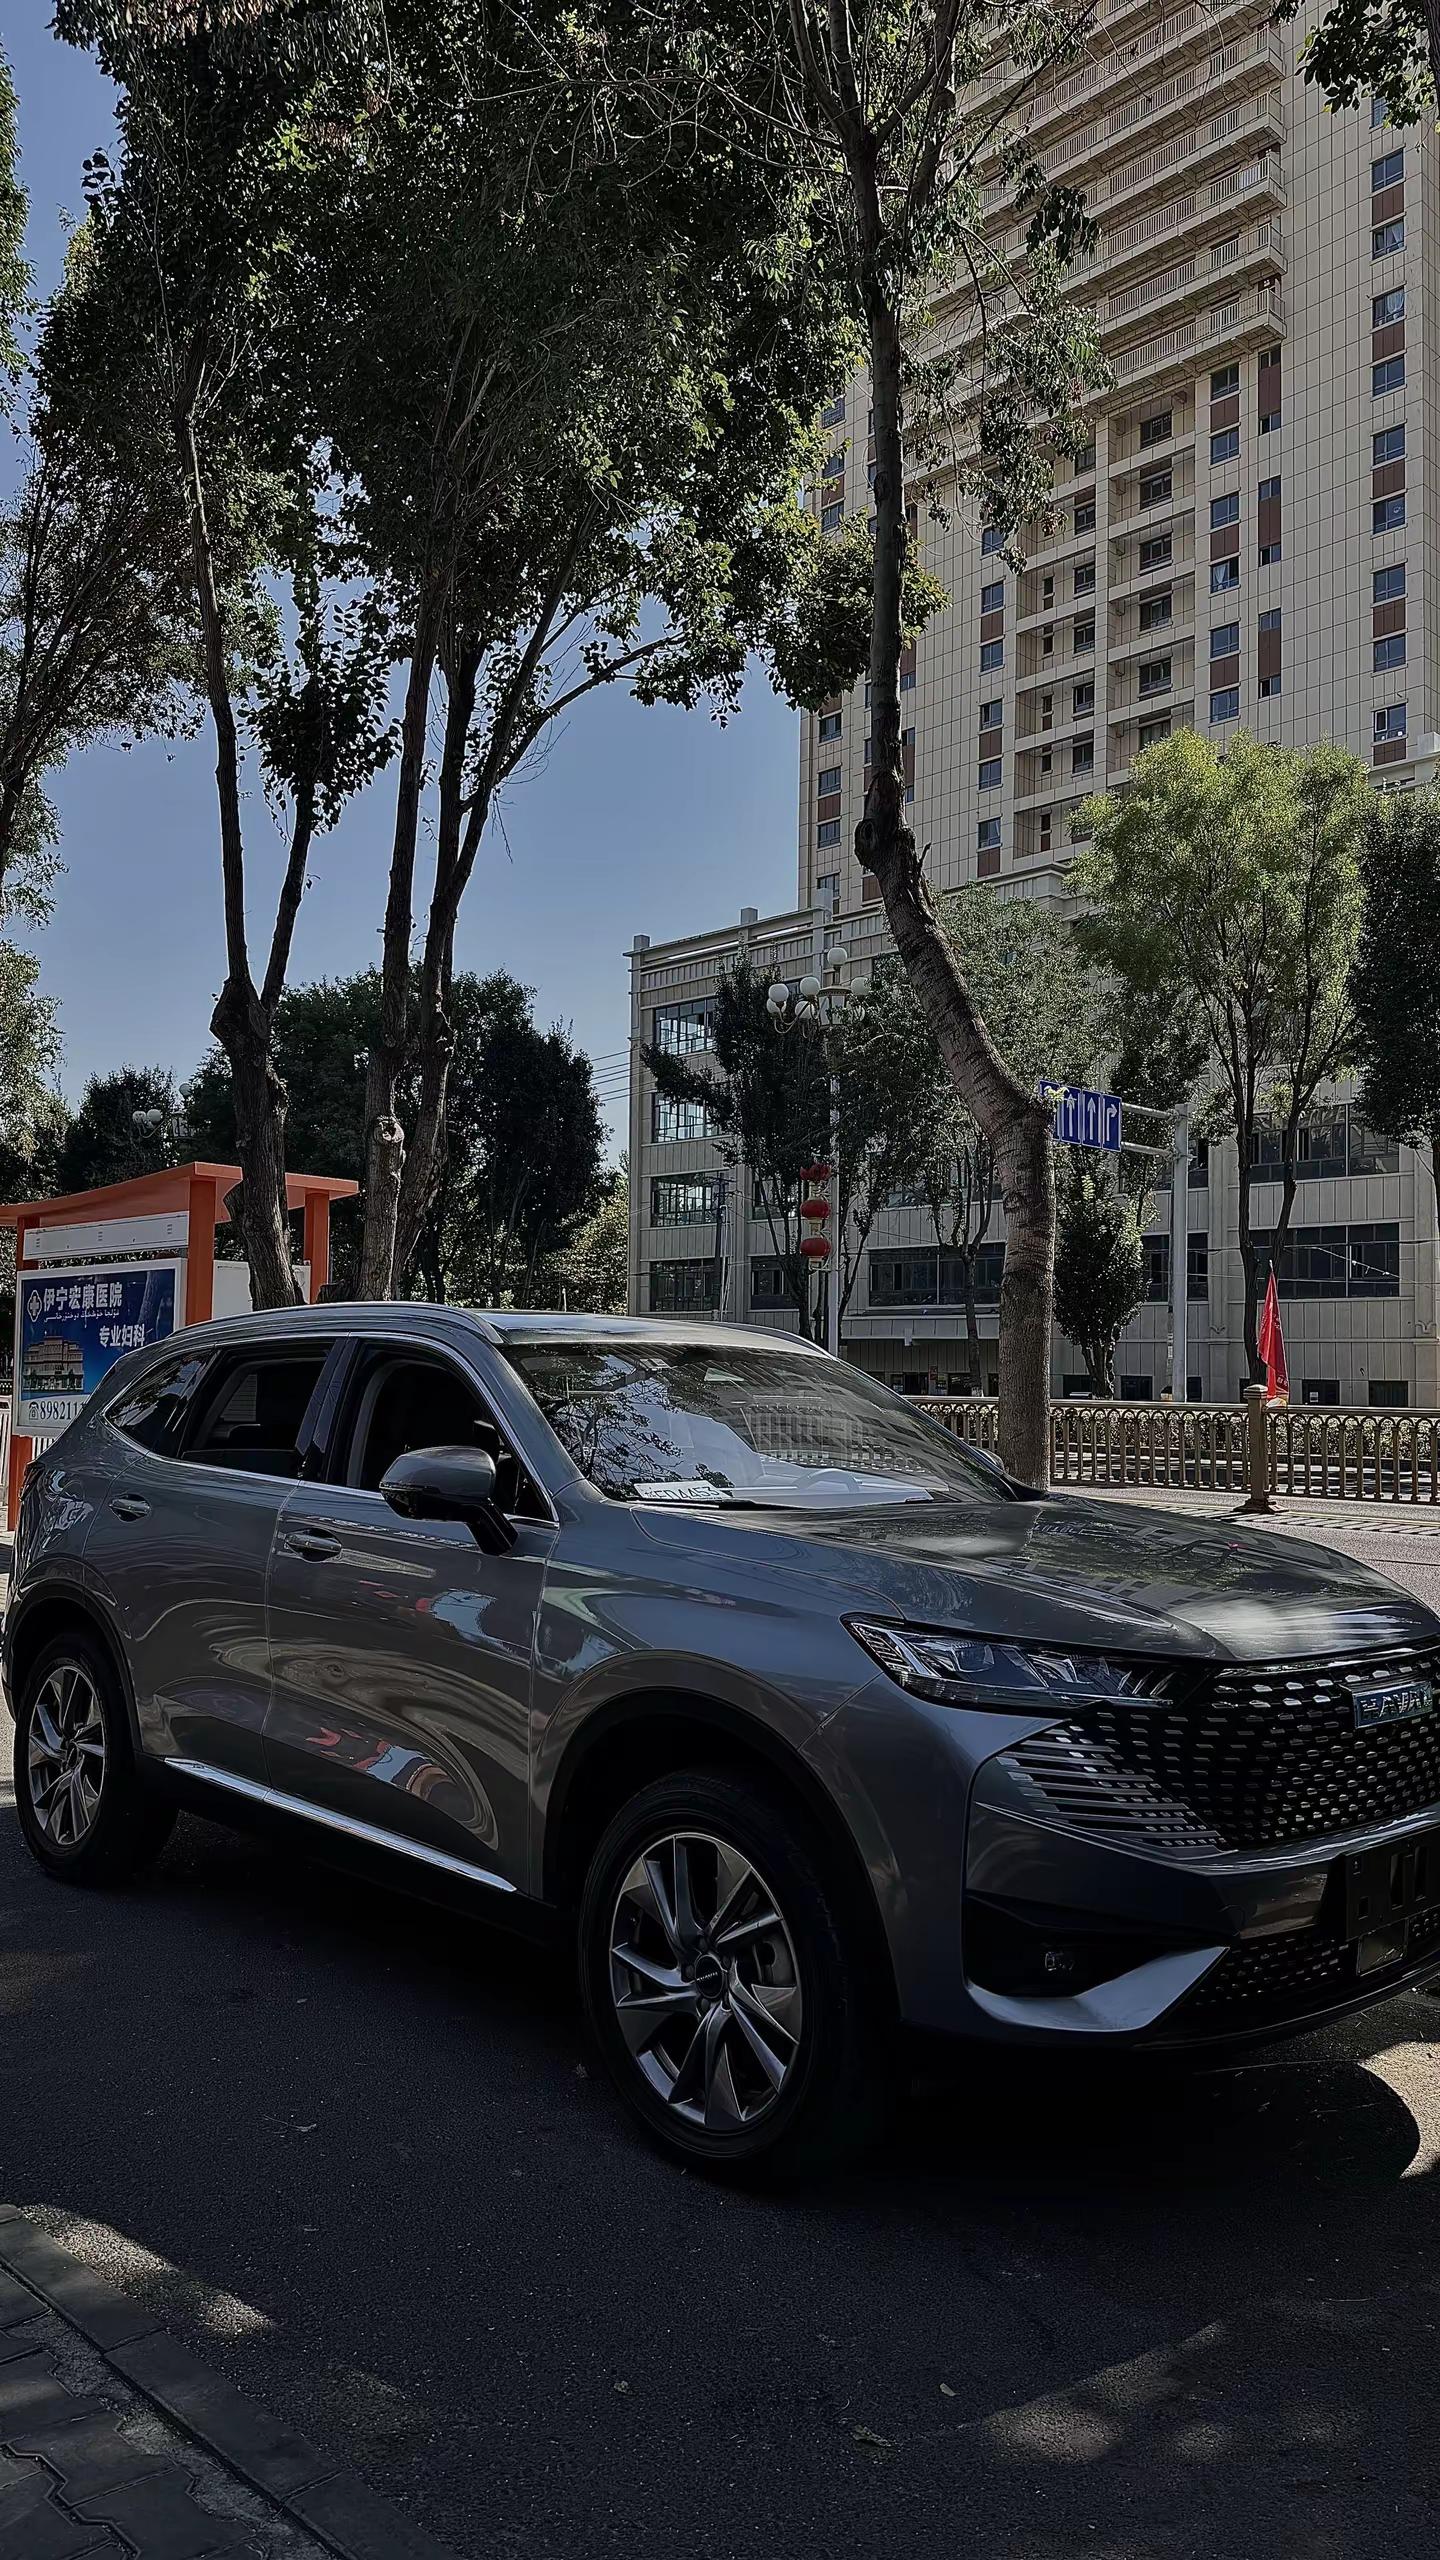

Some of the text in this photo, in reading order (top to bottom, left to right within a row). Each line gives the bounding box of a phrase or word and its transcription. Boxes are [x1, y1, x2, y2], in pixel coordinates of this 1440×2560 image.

[43, 1282, 123, 1312] 伊宁宏康医院
[99, 1323, 146, 1348] 专业妇科
[40, 1401, 84, 1420] 898211
